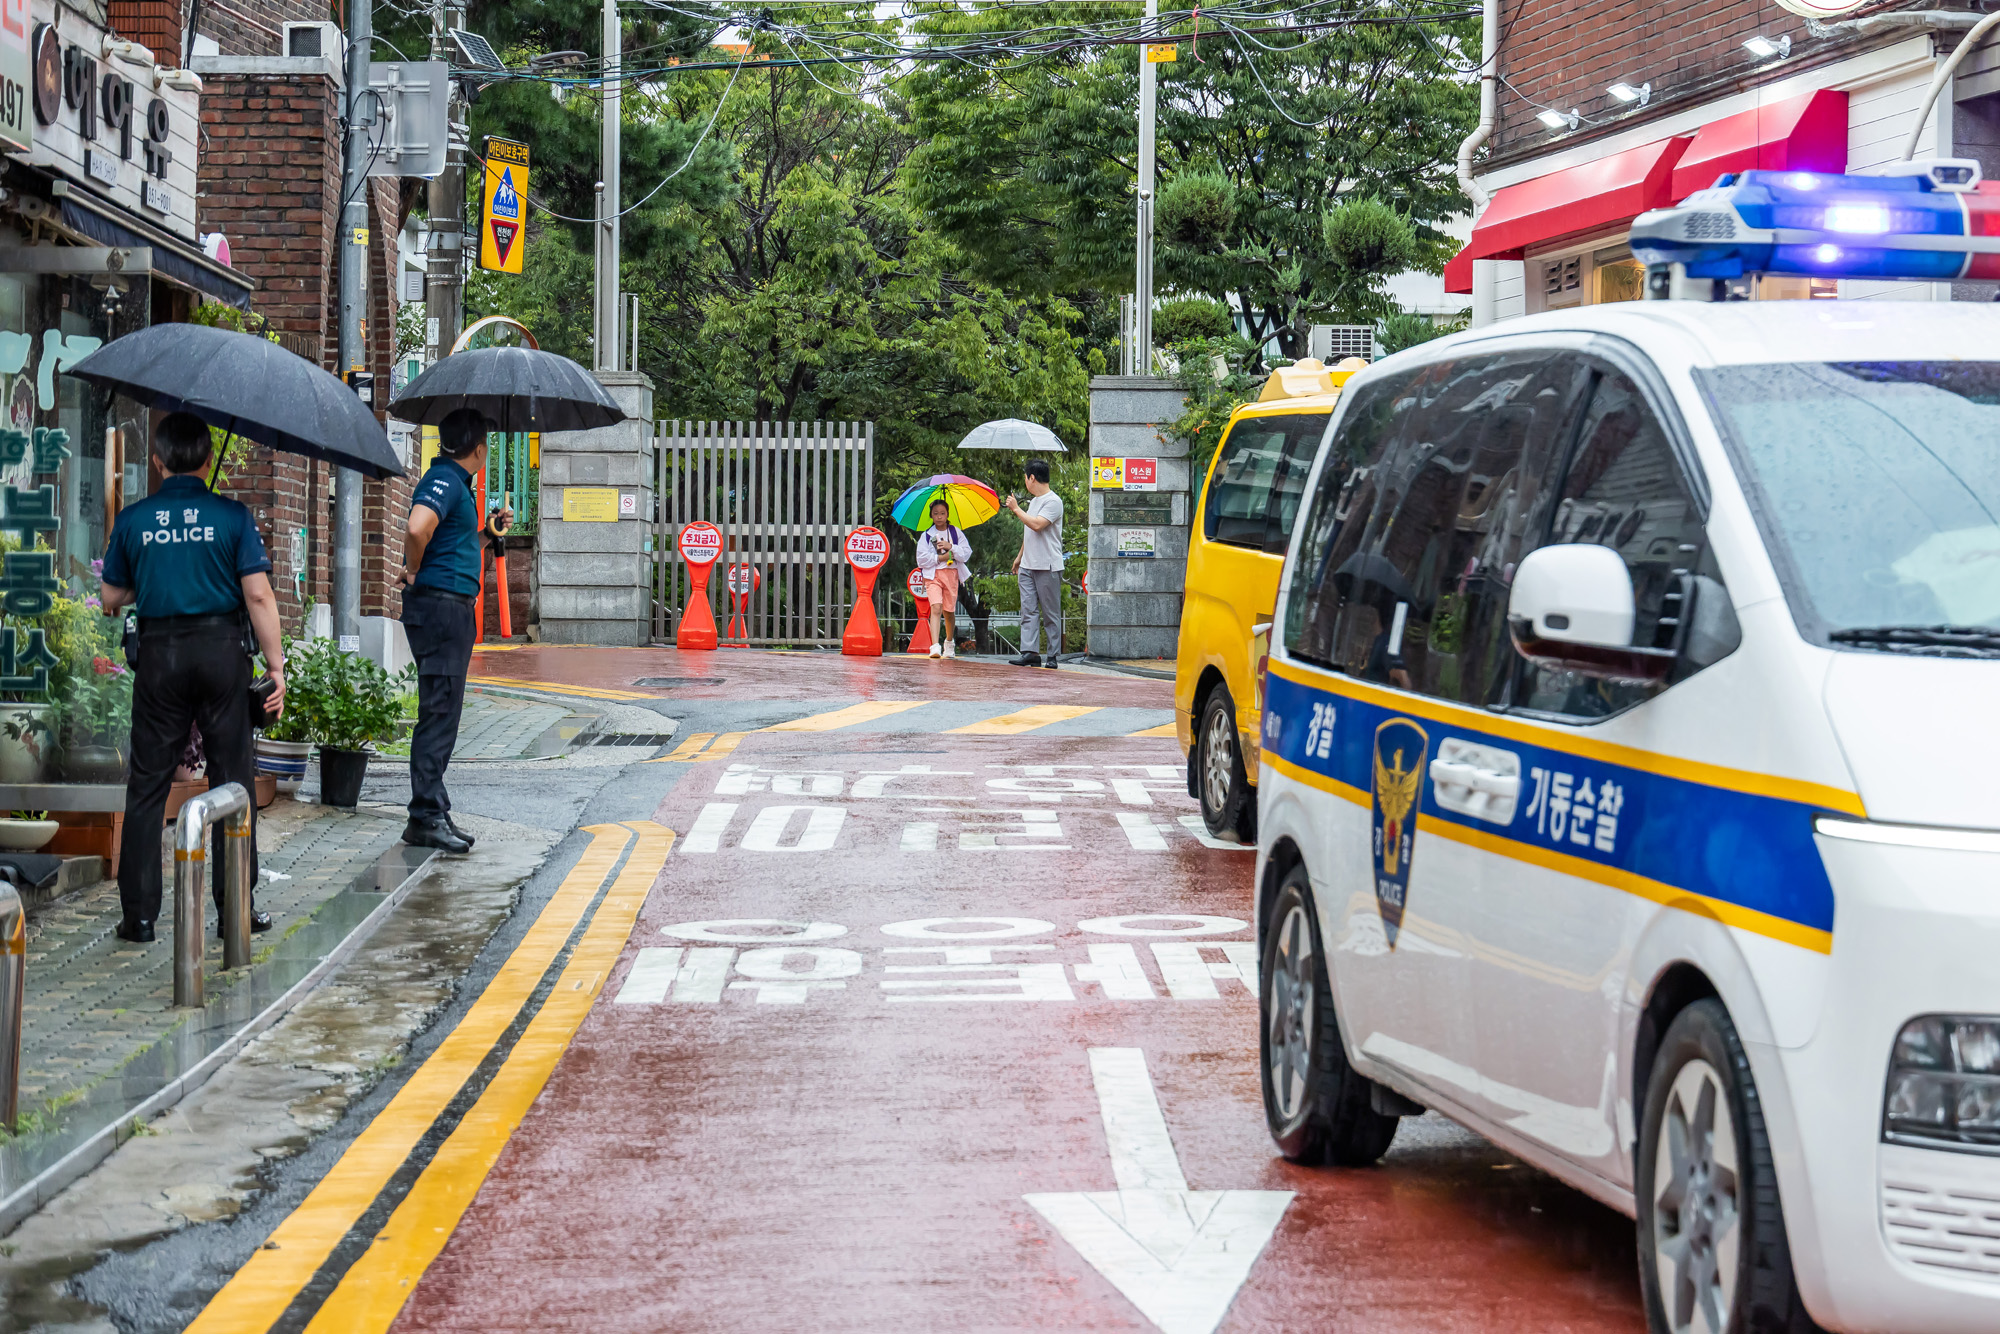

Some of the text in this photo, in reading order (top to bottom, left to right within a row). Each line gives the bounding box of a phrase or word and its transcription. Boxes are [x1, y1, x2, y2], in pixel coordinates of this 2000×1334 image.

[489, 141, 528, 163] 어린이보호구역
[493, 204, 517, 217] 어린이보호
[496, 226, 512, 239] 천천히
[1130, 467, 1152, 476] 에스원
[142, 527, 214, 546] POLICE
[686, 533, 717, 545] 주차금지
[851, 538, 883, 551] 주차금지
[1305, 702, 1337, 759] 경찰
[1525, 766, 1624, 854] 기동순찰
